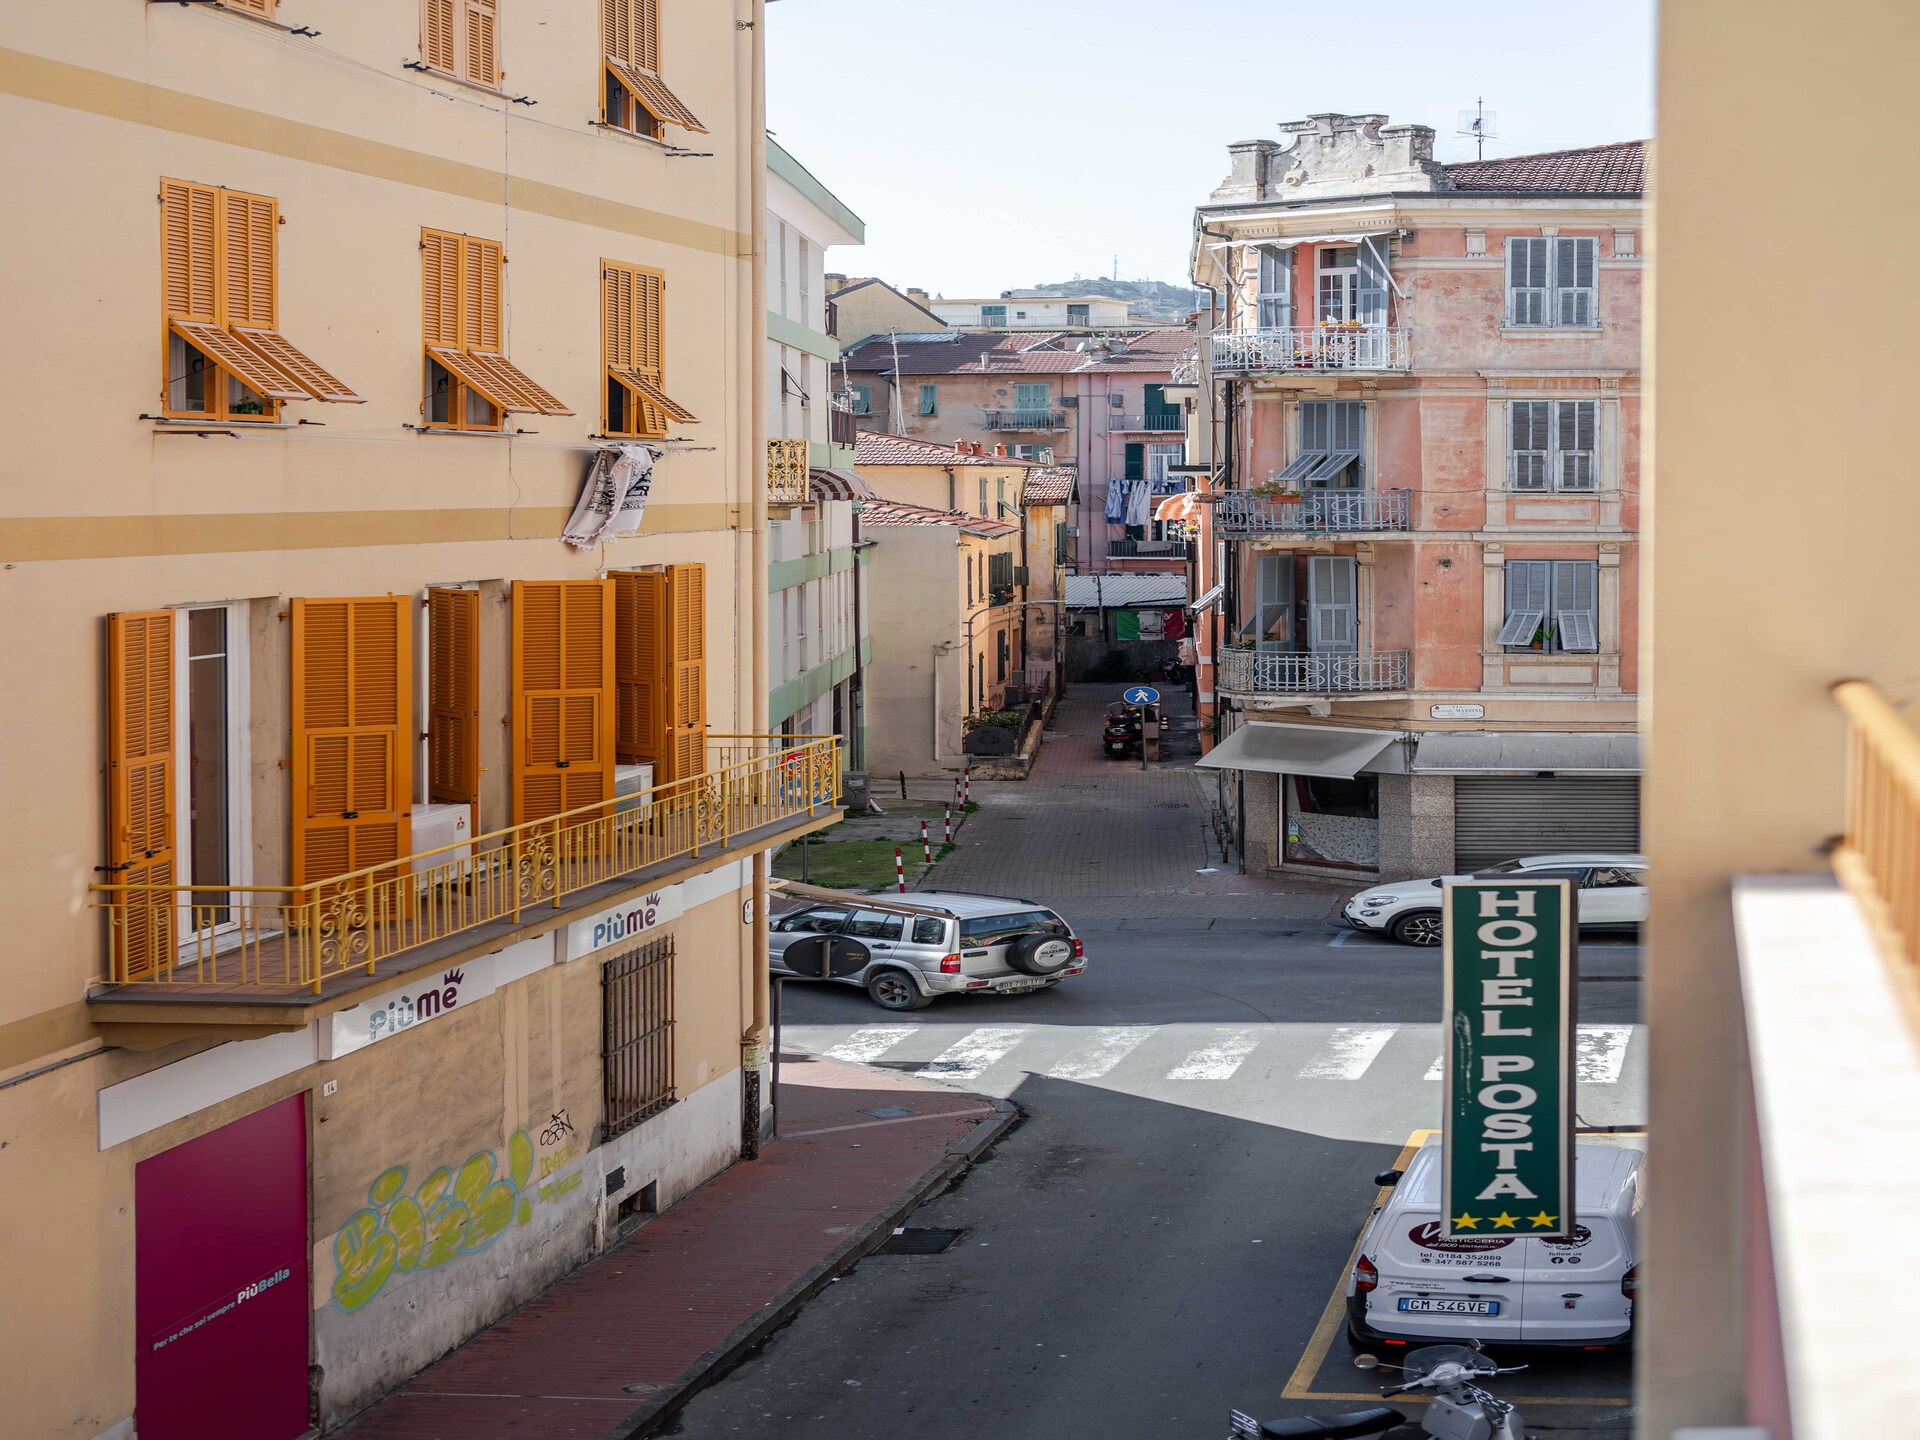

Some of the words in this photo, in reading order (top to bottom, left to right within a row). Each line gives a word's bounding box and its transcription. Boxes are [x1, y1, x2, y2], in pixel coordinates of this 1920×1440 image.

[1041, 947, 1068, 955] SUZUKI
[1477, 890, 1538, 1037] HOTEL
[1475, 1055, 1538, 1200] POSTA
[153, 1339, 168, 1351] Per
[169, 1332, 179, 1342] te
[179, 1324, 194, 1337] che
[194, 1316, 207, 1328] sei
[207, 1301, 236, 1320] sempre
[237, 1268, 290, 1304] PiùBella
